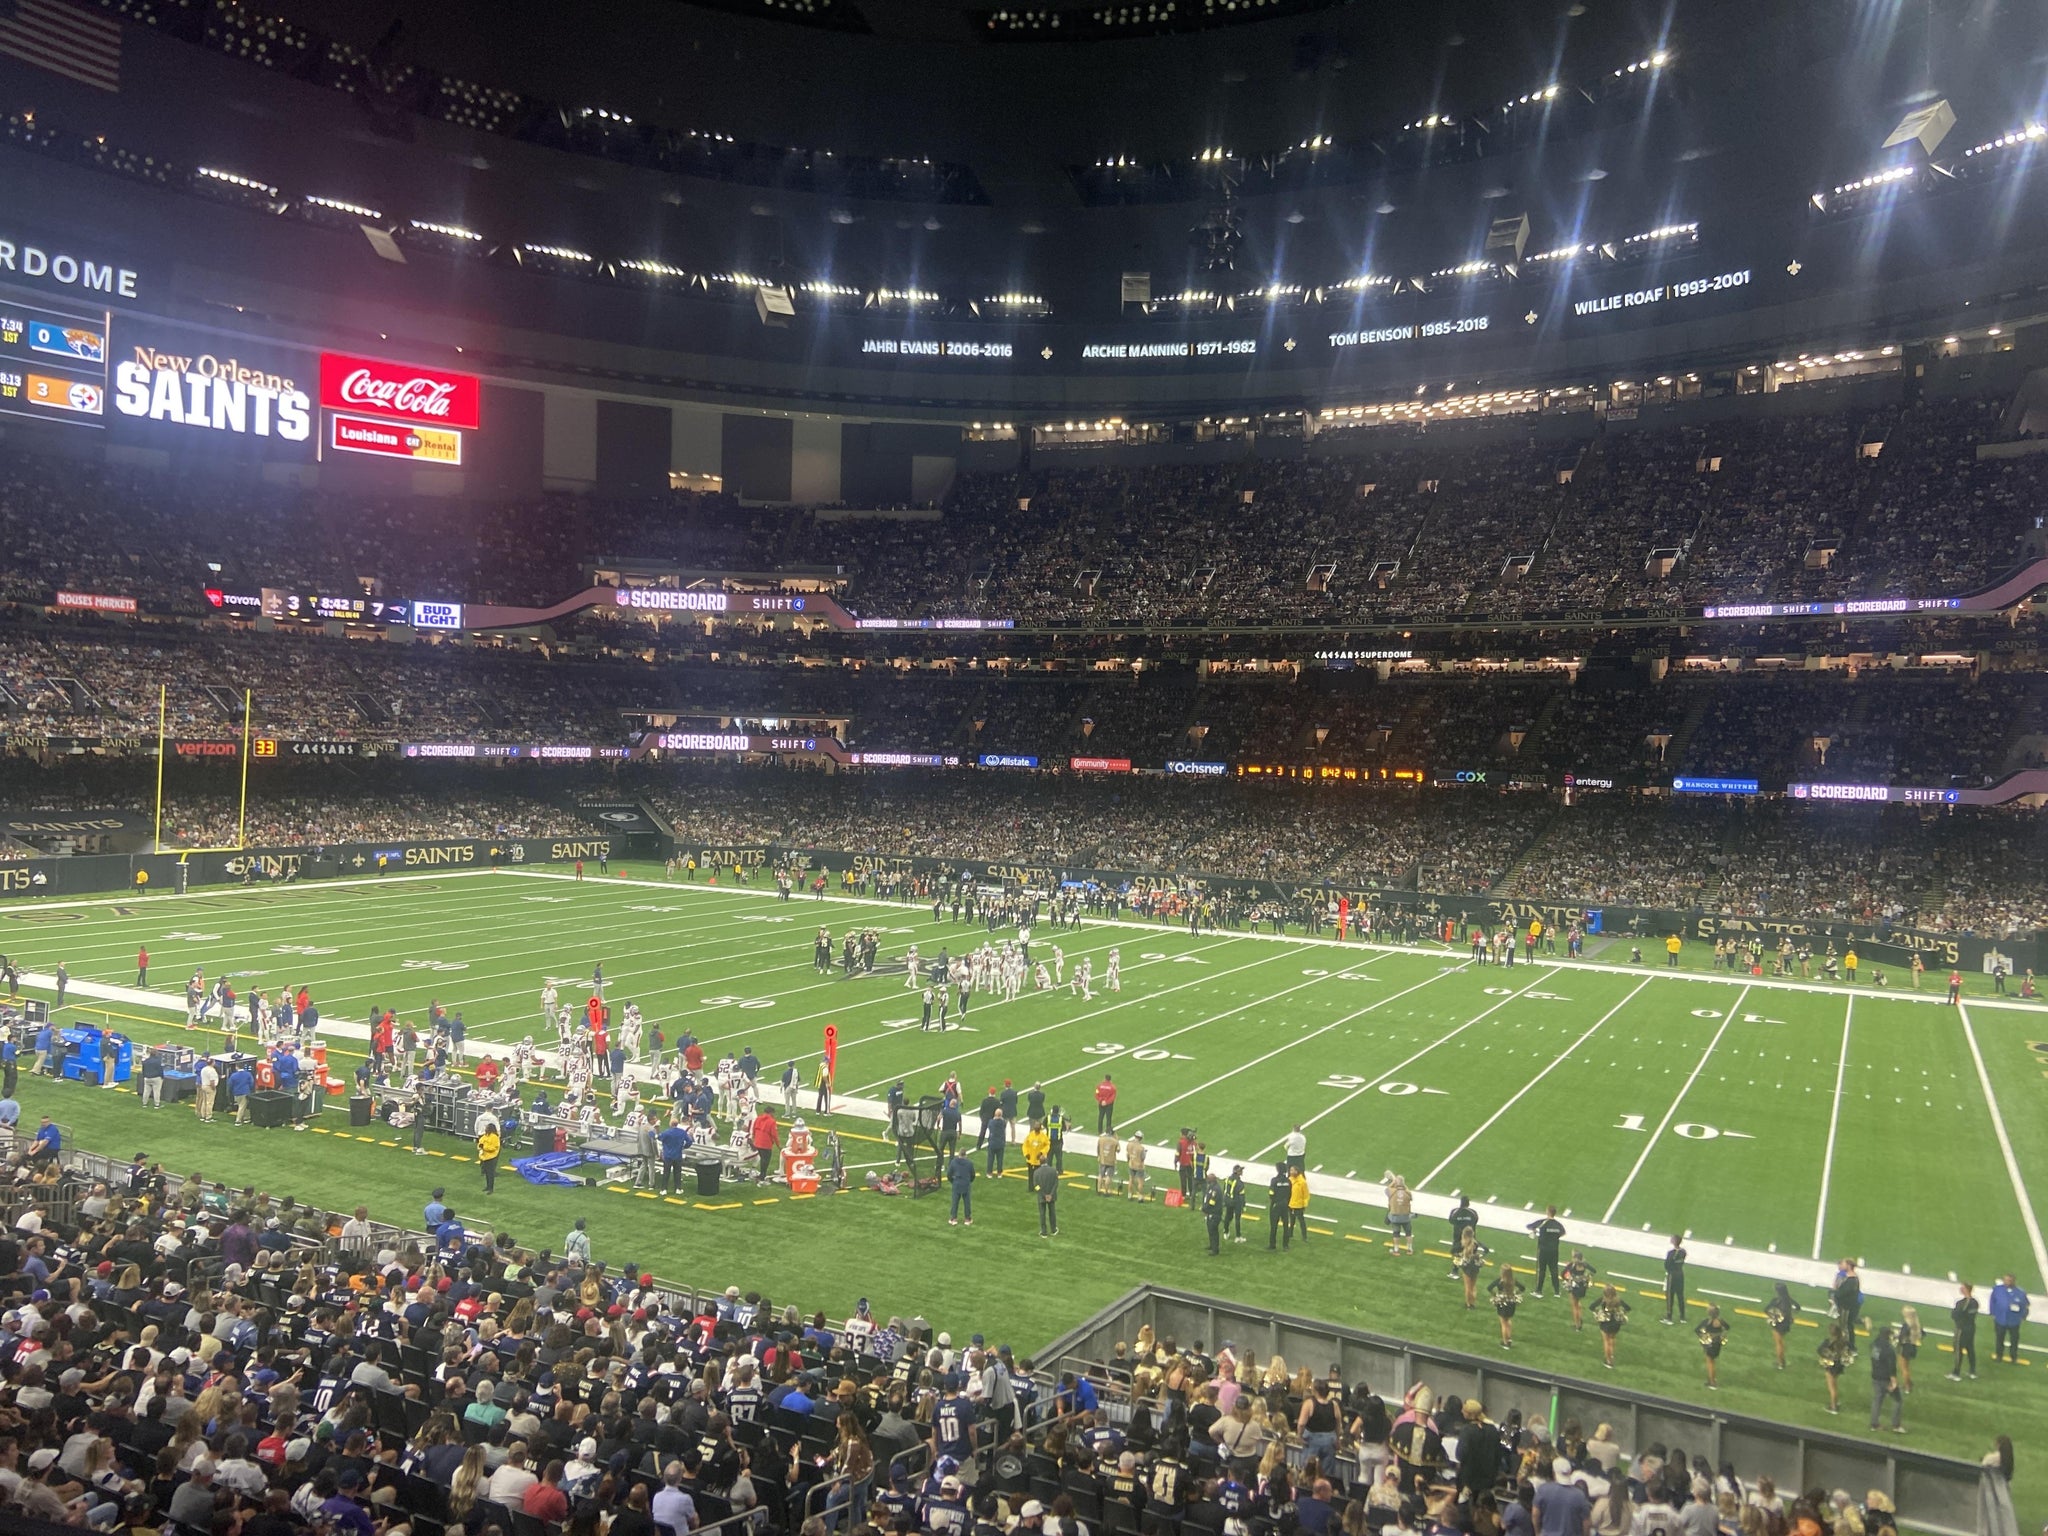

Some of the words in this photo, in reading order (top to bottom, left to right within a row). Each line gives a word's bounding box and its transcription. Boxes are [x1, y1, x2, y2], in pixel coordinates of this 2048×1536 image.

[1574, 295, 1622, 315] WILLIE
[1624, 287, 1663, 307] ROAF
[1672, 270, 1751, 298] 1993-2001
[1, 317, 23, 334] 7:34
[1329, 332, 1357, 347] TOM
[1360, 326, 1412, 344] BENSON
[1420, 316, 1489, 336] 1985-2018
[3, 331, 19, 344] 1ST
[38, 328, 51, 344] 0
[862, 340, 898, 353] JAHRI
[900, 341, 939, 355] EVANS
[946, 342, 1013, 357] 2006-2016
[1082, 344, 1127, 358] ARCHIE
[1129, 343, 1188, 358] MANNING
[1196, 340, 1256, 355] 1971-1982
[133, 346, 192, 375] New
[198, 353, 295, 397] Orleans
[2, 385, 18, 398] 1ST
[37, 382, 49, 397] 3
[340, 367, 457, 417] Coca-Cola
[115, 360, 311, 442] SAINTS
[341, 426, 398, 446] Louisiana
[405, 436, 420, 448] CAT
[424, 441, 457, 453] Rental
[58, 594, 93, 606] ROUSES
[95, 597, 136, 610] MARKETS
[223, 595, 262, 607] TOYOTA
[287, 595, 300, 610] 3
[320, 597, 350, 611] 8:42
[631, 590, 727, 611] SCOREBOARD
[1847, 600, 1906, 613] SCOREBOARD
[371, 602, 385, 616] 7
[423, 605, 452, 615] BUD
[1647, 610, 1686, 618] SAINTS
[1717, 605, 1773, 617] SCOREBOARD
[417, 614, 458, 625] LIGHT
[1340, 617, 1374, 625] SAINTS
[1411, 616, 1447, 624] SAINTS
[1563, 612, 1602, 620] SAINTS
[862, 619, 898, 628] SCOREBOARD
[943, 619, 982, 628] SCOREBOARD
[1206, 619, 1237, 627] SAINTS
[1901, 643, 1943, 651] SAINTS
[1995, 640, 2040, 649] SAINTS
[1314, 651, 1360, 659] CAESARS
[1360, 650, 1412, 659] SUPERDOME
[5, 736, 49, 747] SAINTS
[100, 738, 141, 747] SAINTS
[175, 741, 237, 755] verizon
[255, 740, 275, 754] 33
[361, 743, 396, 751] SAINTS
[667, 734, 749, 750] SCOREBOARD
[292, 744, 354, 755] CAESARS
[420, 745, 476, 756] SCOREBOARD
[541, 747, 592, 758] SCOREBOARD
[863, 754, 911, 764] SCOREBOARD
[943, 757, 959, 765] 1:58
[1000, 756, 1030, 766] Allstate
[1175, 762, 1225, 774] Ochsner
[1344, 770, 1356, 779] 44
[1456, 771, 1487, 783] COX
[1576, 776, 1613, 789] entergy
[1685, 781, 1719, 789] HANCOCK
[1721, 783, 1758, 791] WHITNEY
[1811, 785, 1888, 800] SCOREBOARD
[8, 819, 124, 831] SAINTS
[405, 845, 474, 865] SAINTS
[552, 841, 610, 859] SAINTS
[231, 854, 302, 875] SAINT
[853, 856, 913, 871] SAIT
[700, 995, 776, 1009] 50
[559, 1047, 571, 1057] 28
[1082, 1042, 1171, 1062] 30
[261, 1067, 271, 1083] G
[573, 1072, 587, 1083] 86
[731, 1079, 741, 1089] 17
[1317, 1074, 1419, 1096] 20
[1612, 1114, 1720, 1140] 10
[695, 1134, 706, 1145] 71
[731, 1135, 744, 1147] 76
[796, 1136, 803, 1144] G
[737, 1312, 753, 1330] 10
[845, 1332, 867, 1351] 93
[313, 1388, 334, 1413] 10
[731, 1404, 756, 1426] 87
[940, 1406, 957, 1416] MAYE
[939, 1417, 960, 1442] 10
